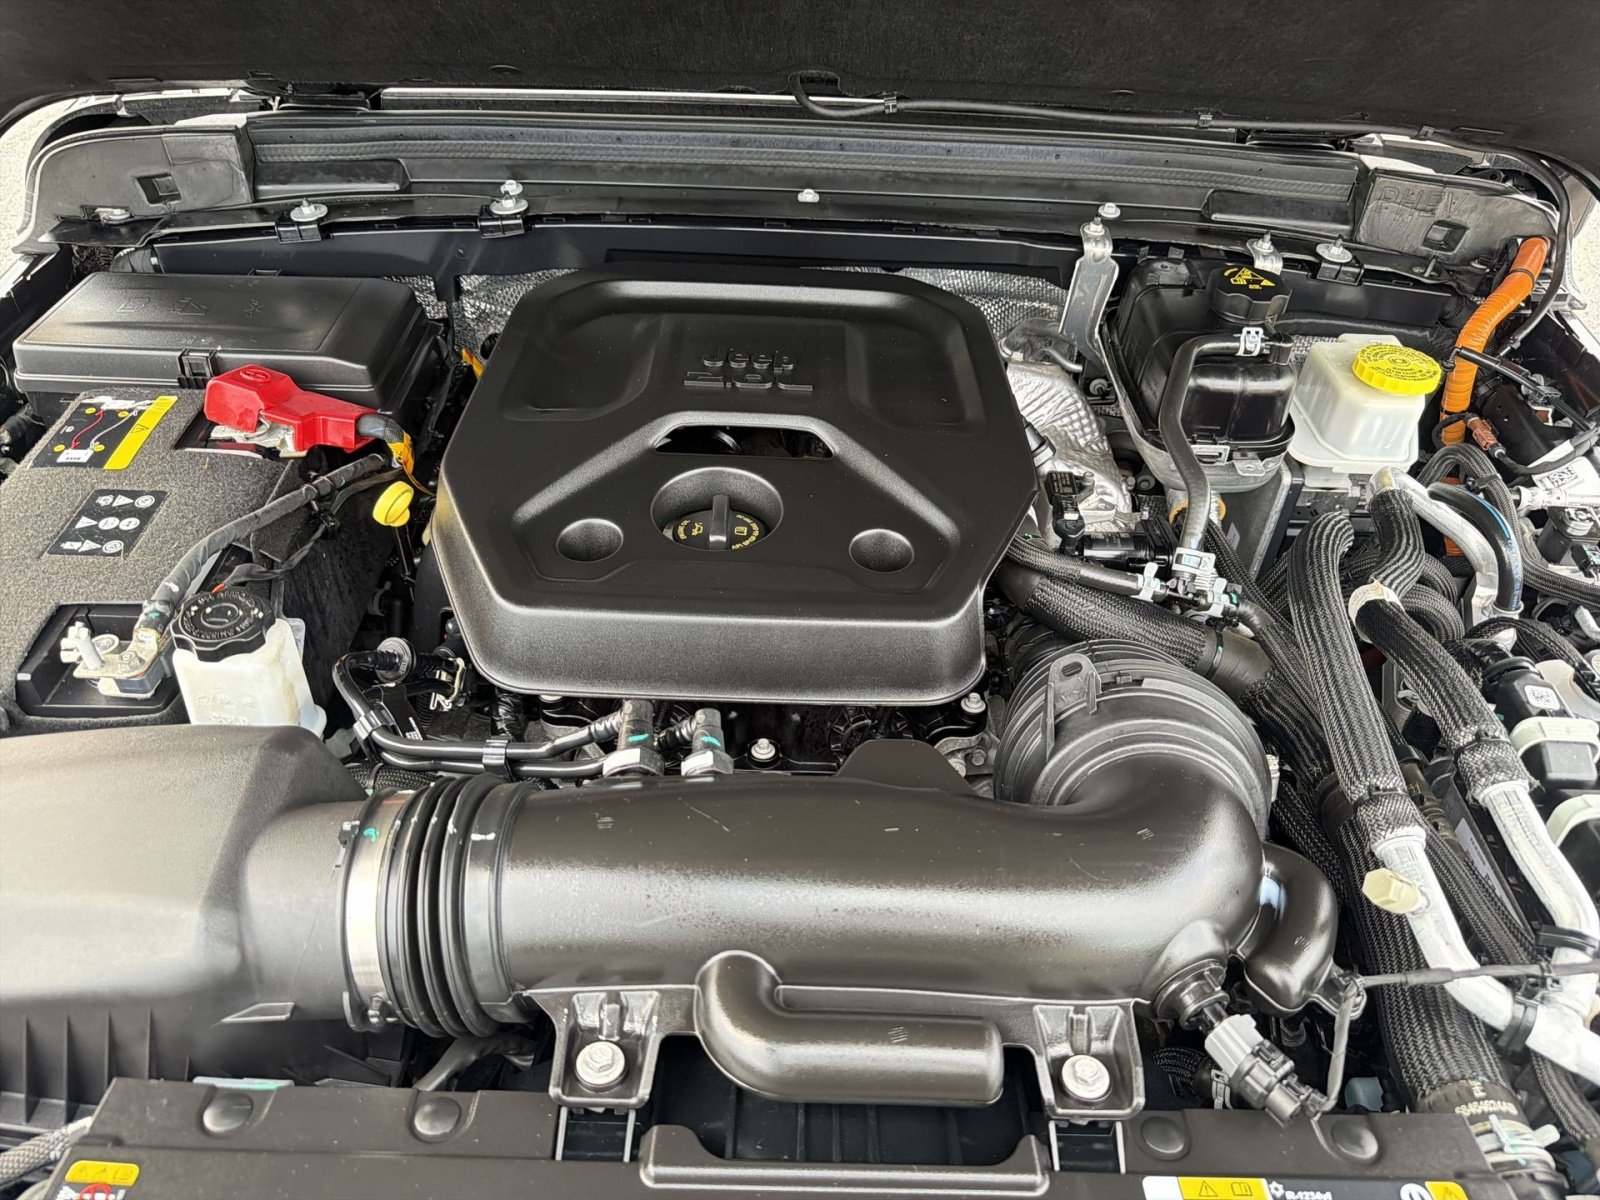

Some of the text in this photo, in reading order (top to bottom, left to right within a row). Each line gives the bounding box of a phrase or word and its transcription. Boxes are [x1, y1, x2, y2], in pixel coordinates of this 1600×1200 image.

[1376, 185, 1470, 220] PHEV
[702, 347, 797, 374] Jeep
[683, 371, 813, 391] 2.0L
